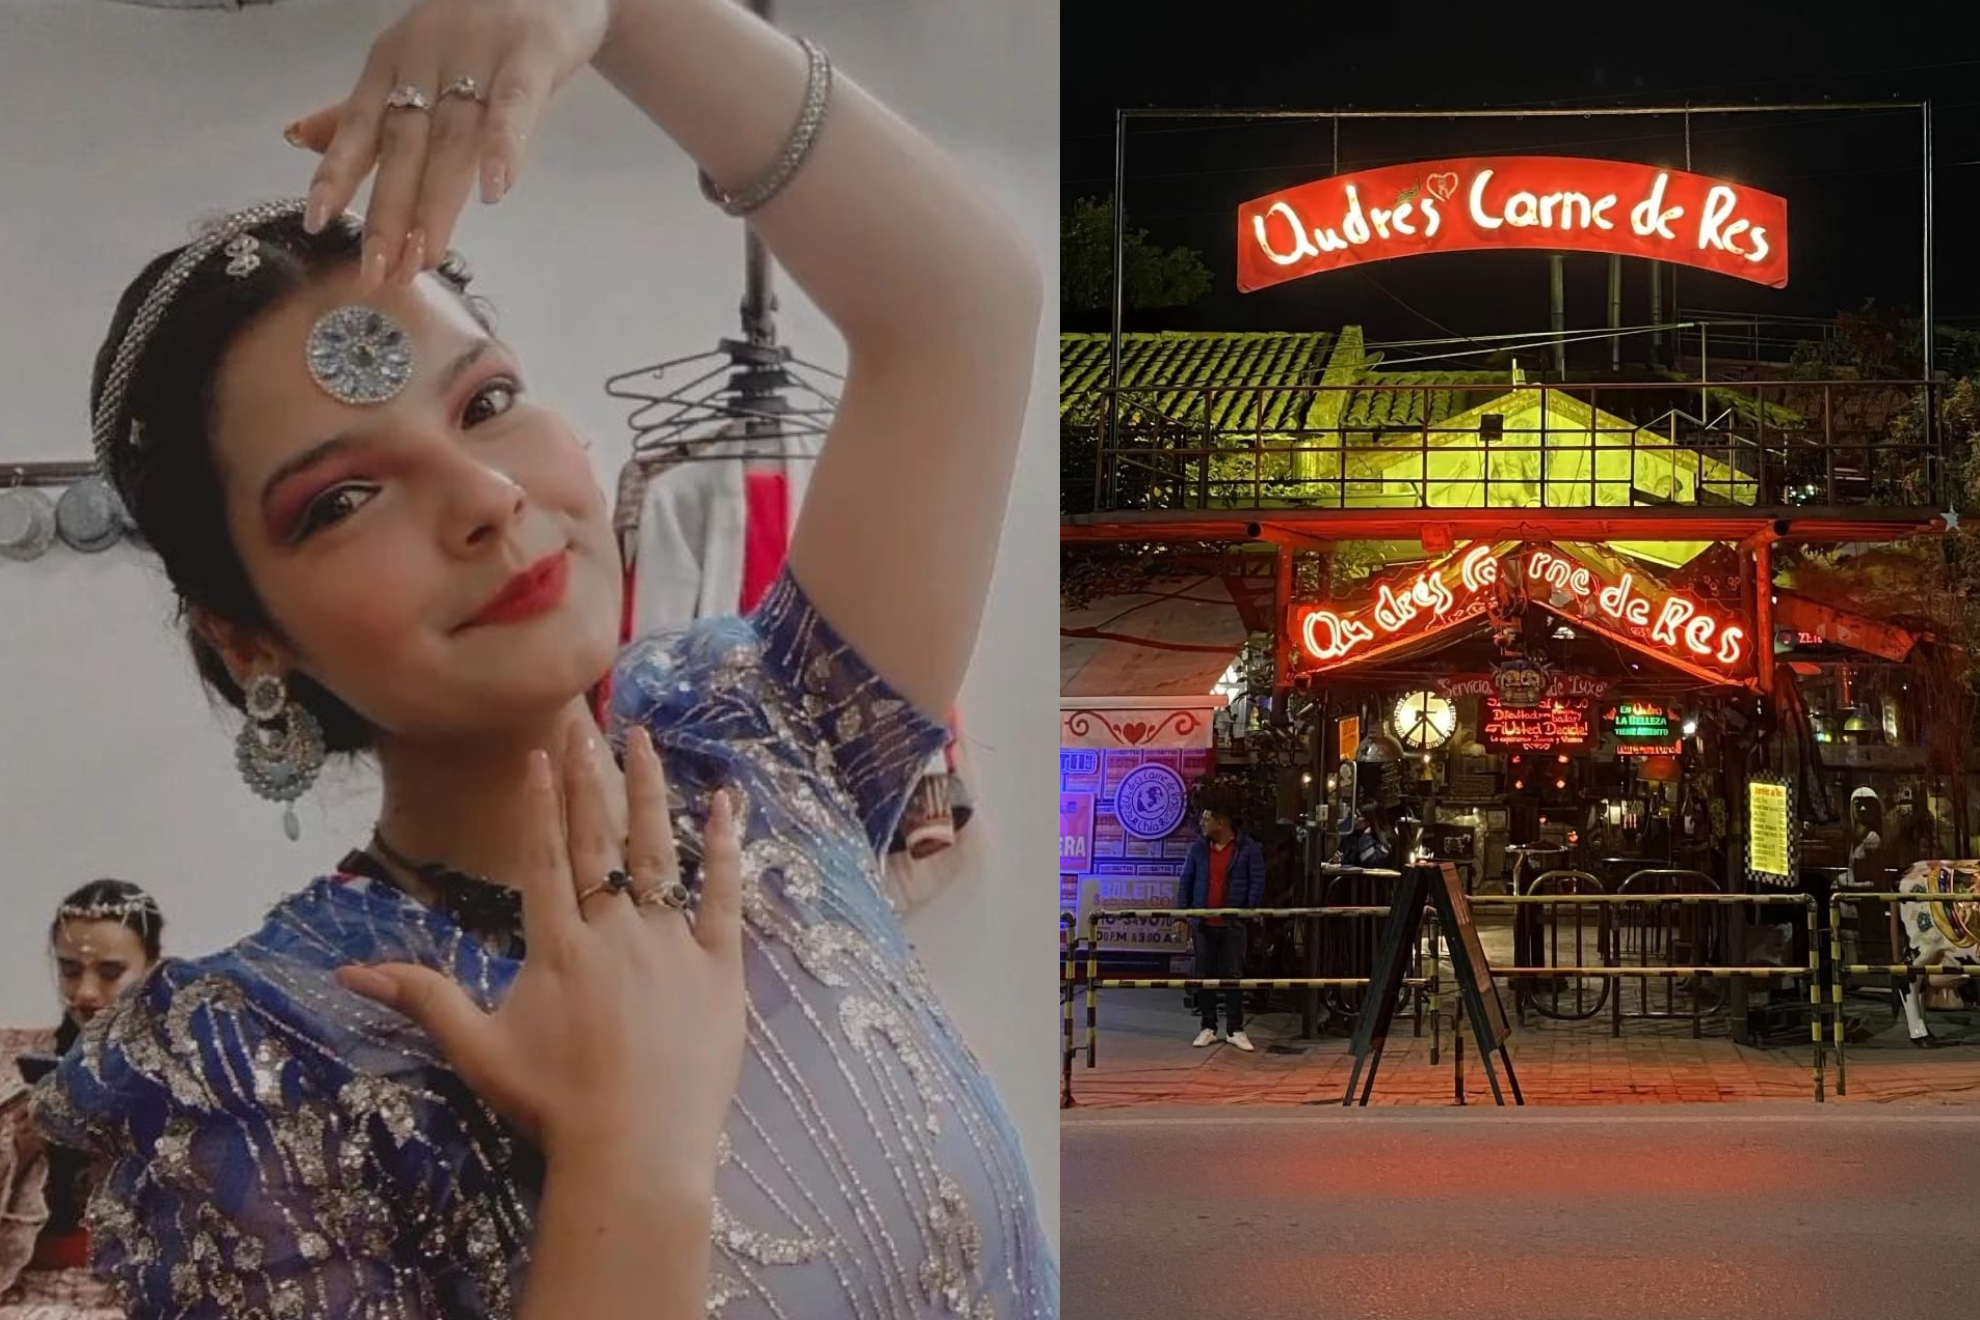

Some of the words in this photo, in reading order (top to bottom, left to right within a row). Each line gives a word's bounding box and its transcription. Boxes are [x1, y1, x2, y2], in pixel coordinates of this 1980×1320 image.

[1468, 169, 1618, 231] Carne
[1630, 172, 1686, 240] de
[1699, 186, 1770, 262] Res
[1599, 573, 1651, 625] de
[1652, 596, 1744, 664] Res
[1550, 677, 1563, 697] de
[1060, 836, 1086, 857] RA
